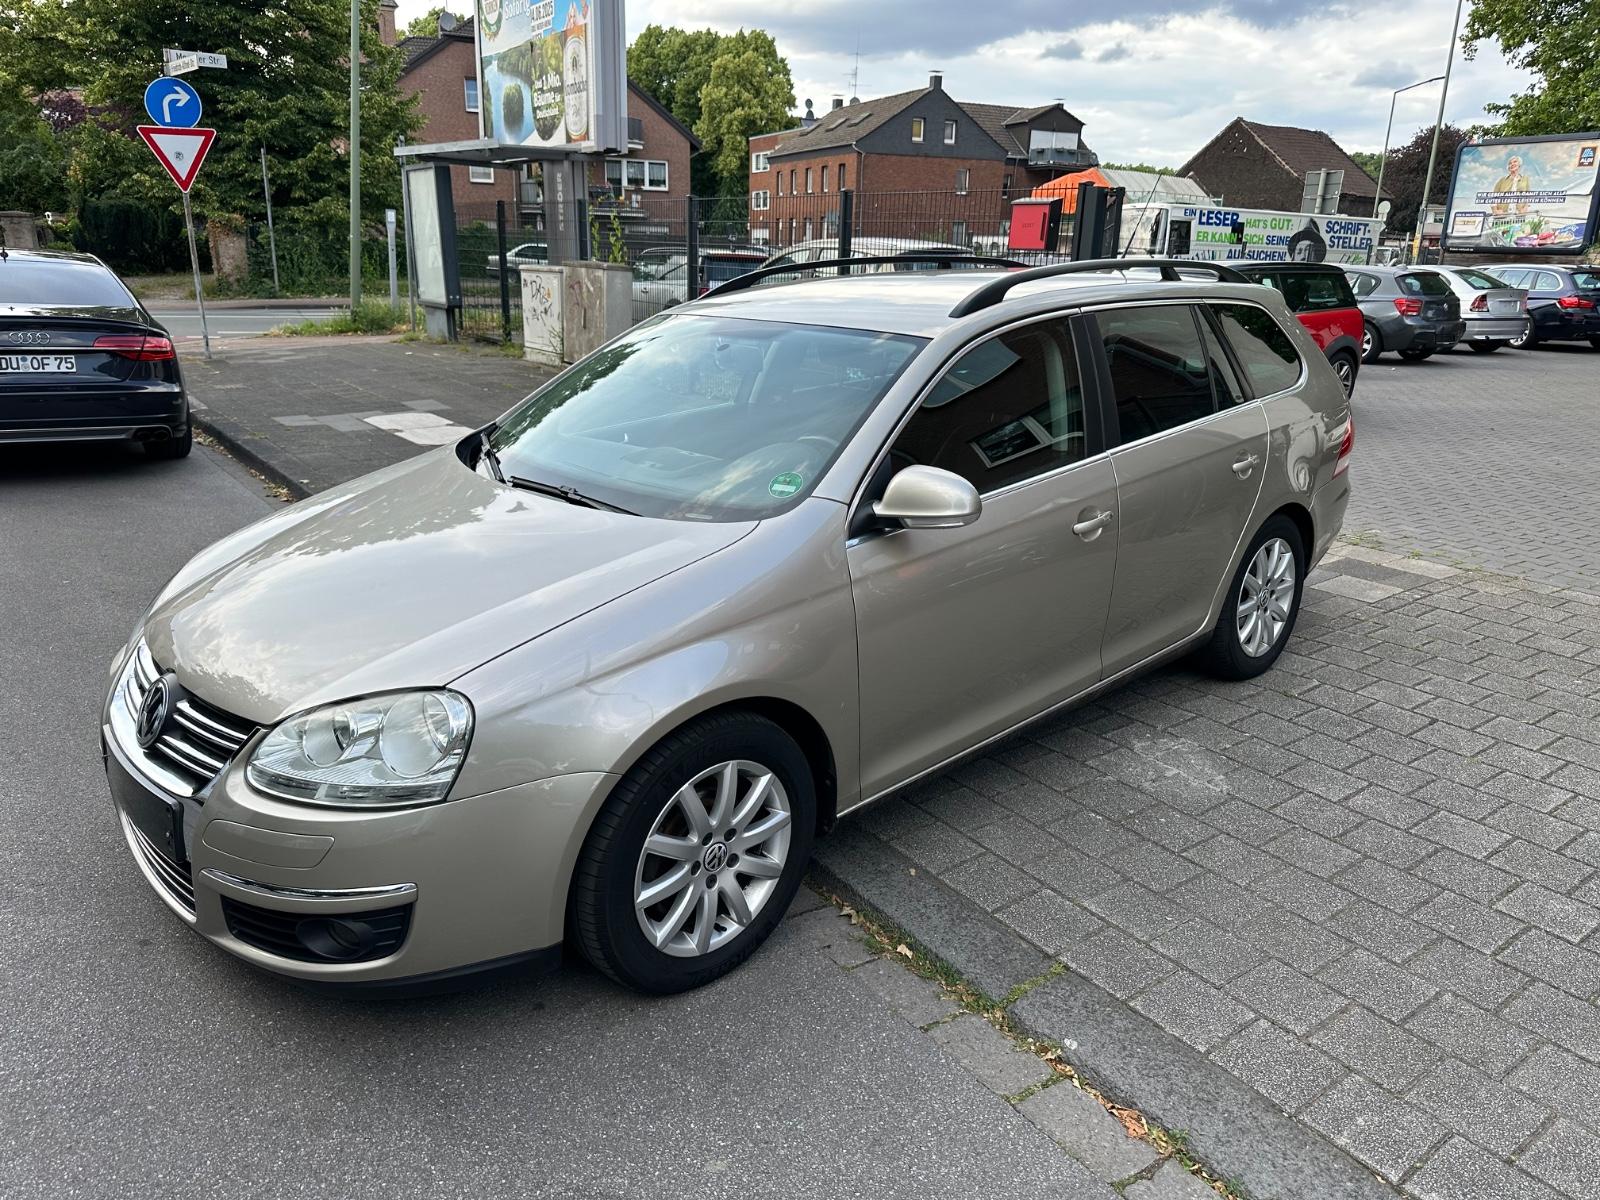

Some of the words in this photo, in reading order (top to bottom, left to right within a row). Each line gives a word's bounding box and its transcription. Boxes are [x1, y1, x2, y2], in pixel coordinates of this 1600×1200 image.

[1184, 208, 1197, 217] EIN
[1198, 209, 1240, 227] LESER
[1244, 217, 1268, 229] HAT'S
[1269, 217, 1294, 231] GUT:
[1325, 220, 1371, 236] SCHRIFT-
[1196, 231, 1209, 242] ER
[1211, 231, 1238, 244] KANN
[1243, 232, 1265, 245] SICH
[1265, 234, 1291, 246] SEINE
[1329, 236, 1373, 250] STELLER
[0, 356, 20, 370] DU
[30, 356, 50, 370] OF
[54, 356, 75, 370] 75
